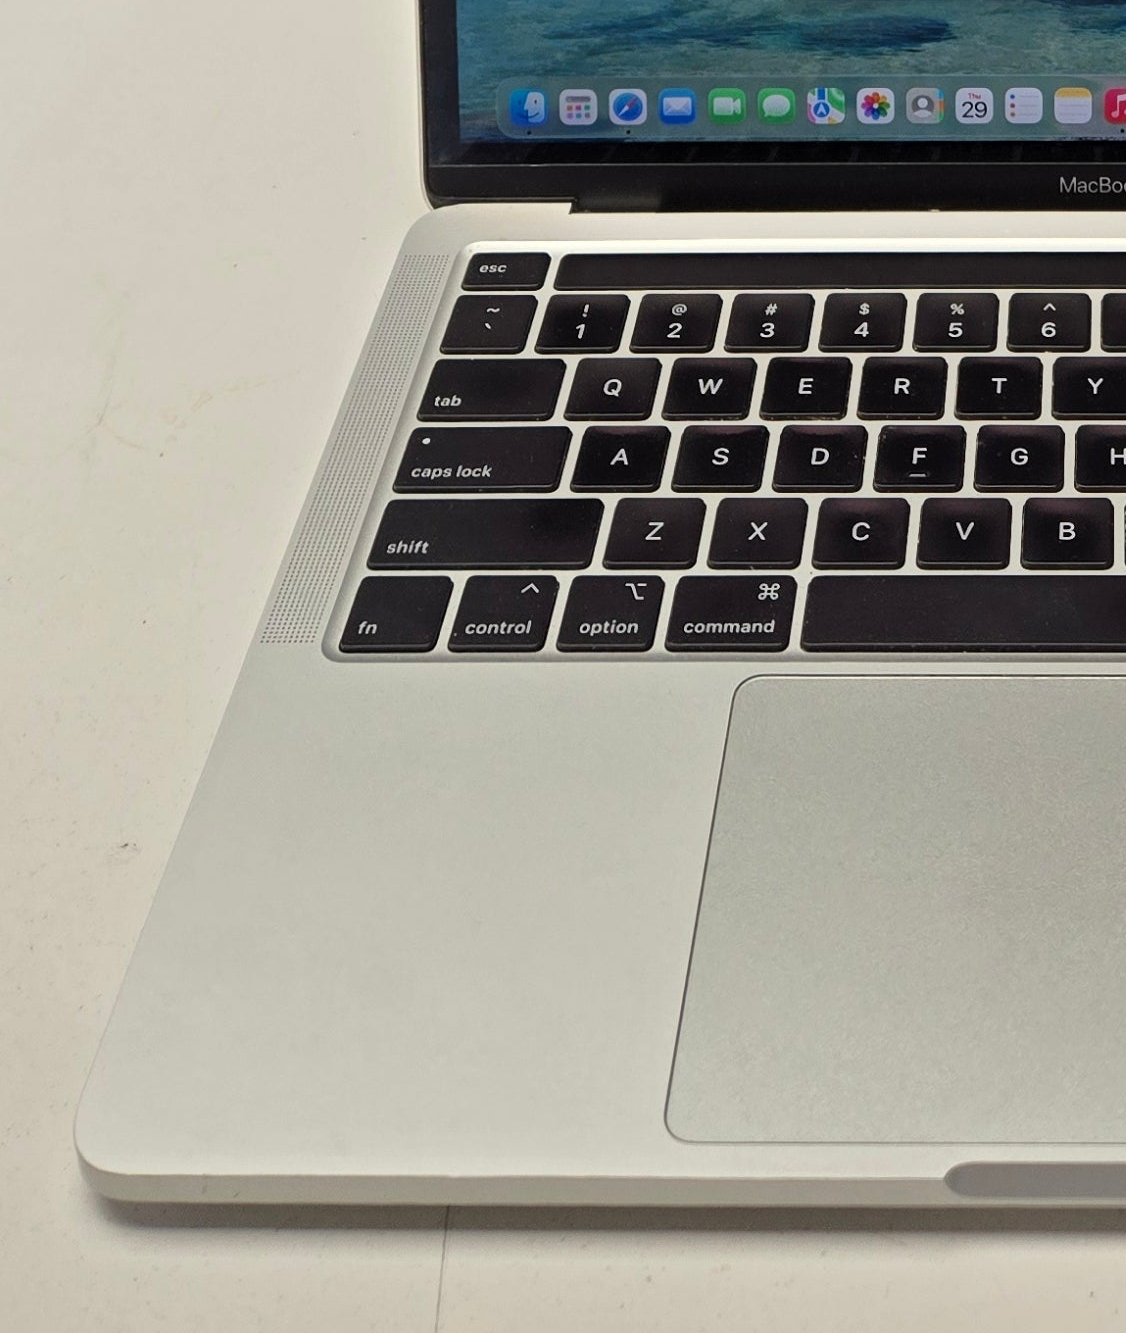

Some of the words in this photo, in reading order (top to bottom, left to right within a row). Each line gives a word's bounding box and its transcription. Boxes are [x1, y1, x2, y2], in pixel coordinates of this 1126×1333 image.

[961, 102, 988, 118] 29
[479, 263, 507, 274] esc
[577, 324, 586, 338] 1
[667, 323, 682, 338] 2
[760, 323, 775, 338] 3
[853, 323, 869, 337] 4
[948, 323, 963, 337] 5
[1041, 323, 1057, 337] 6
[603, 378, 623, 398] Q
[698, 378, 723, 395] W
[798, 378, 813, 395] E
[893, 378, 910, 395] R
[991, 378, 1007, 395] T
[1087, 378, 1104, 395] Y
[434, 394, 462, 407] tab
[611, 448, 629, 465] A
[712, 448, 729, 466] S
[812, 448, 829, 465] D
[912, 448, 927, 465] F
[1010, 448, 1028, 466] G
[411, 465, 453, 481] caps
[457, 464, 492, 479] lock
[647, 522, 663, 541] Z
[748, 522, 767, 541] X
[852, 521, 870, 541] C
[955, 522, 975, 540] V
[1059, 521, 1075, 540] B
[386, 540, 429, 555] shift
[358, 620, 378, 635] fn
[465, 620, 532, 635] control
[579, 620, 639, 637] option
[683, 619, 775, 635] command
